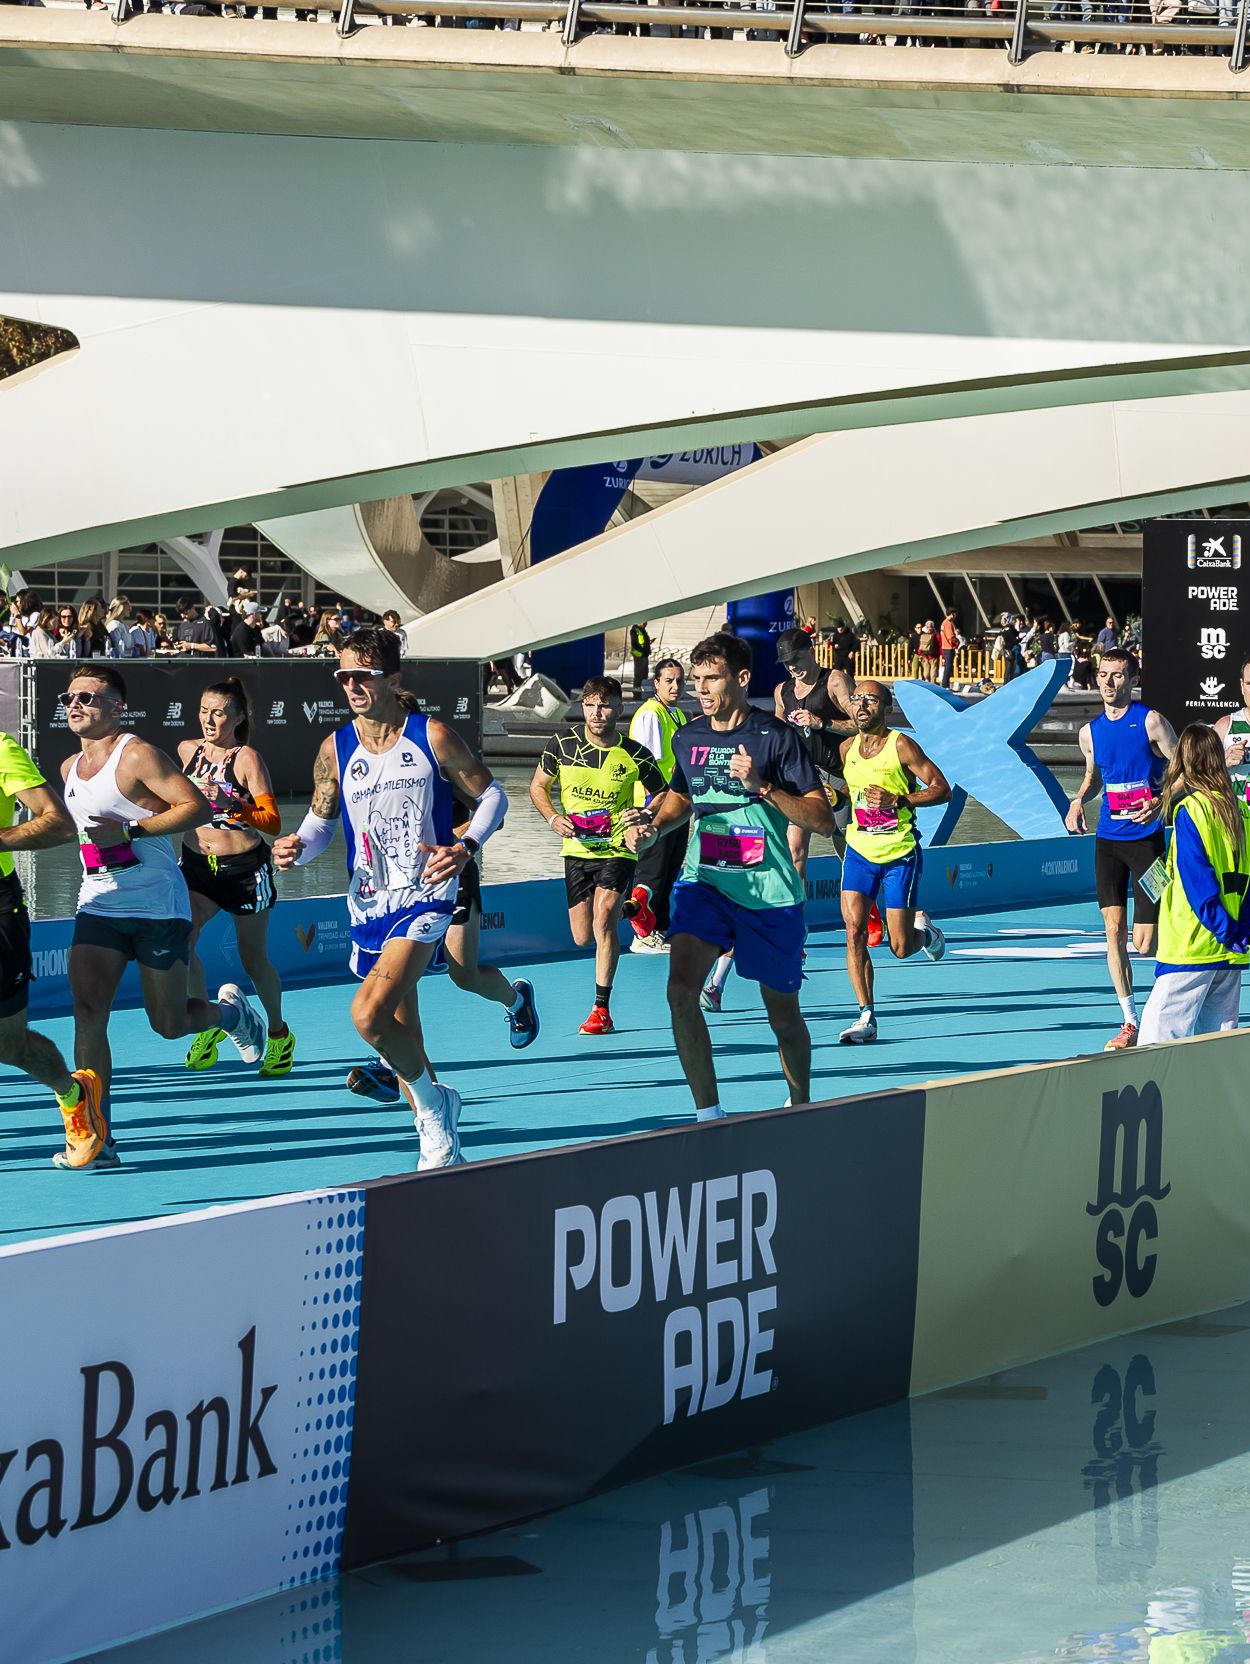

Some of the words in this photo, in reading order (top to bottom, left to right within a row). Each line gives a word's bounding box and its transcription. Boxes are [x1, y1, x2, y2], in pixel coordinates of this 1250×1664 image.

[1196, 559, 1232, 568] CaixaBank
[1188, 586, 1238, 599] POWER
[1210, 599, 1238, 611] ADE
[690, 746, 710, 766] 17
[383, 777, 426, 794] ATLETISMO
[571, 786, 621, 800] ALBALAT
[553, 1168, 778, 1325] POWER
[662, 1285, 778, 1426] ADE
